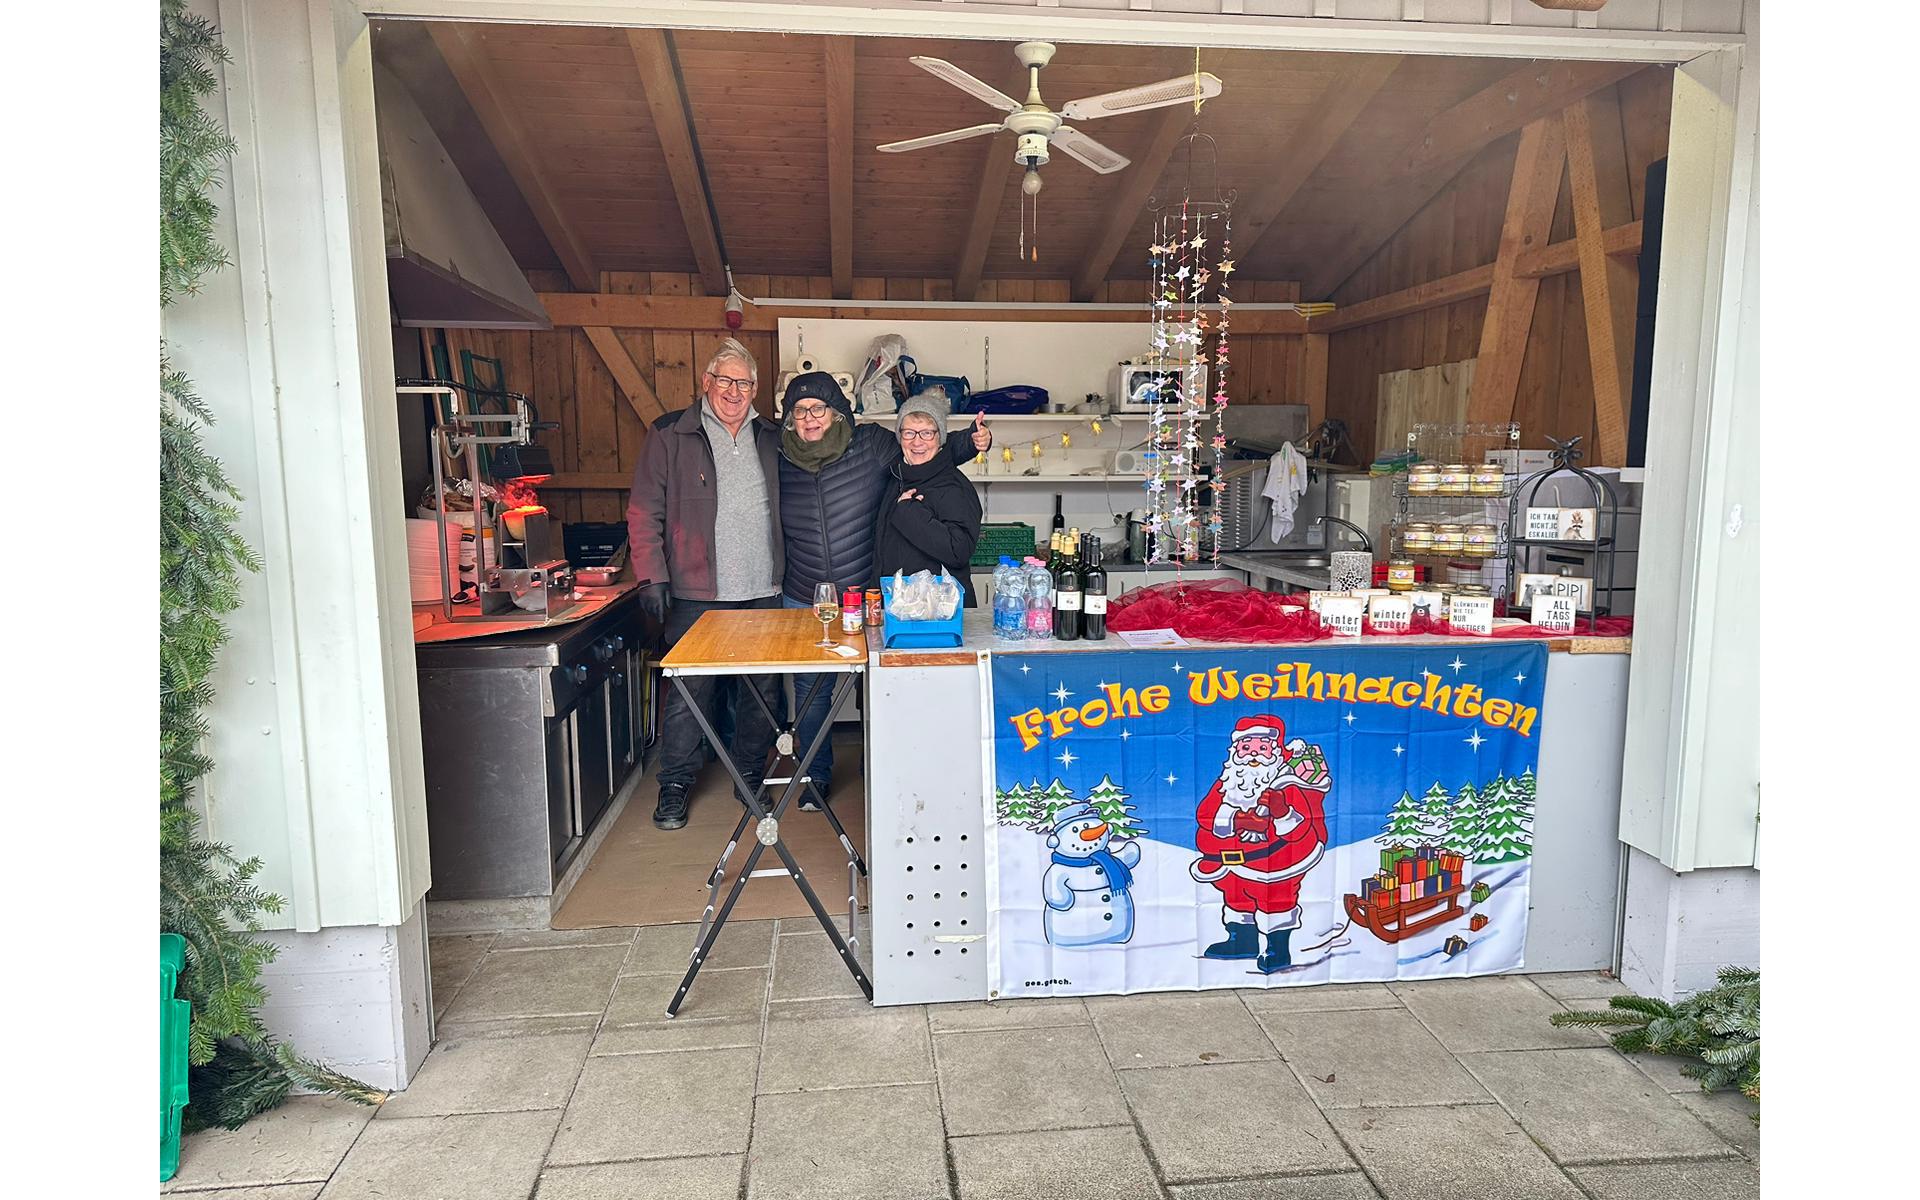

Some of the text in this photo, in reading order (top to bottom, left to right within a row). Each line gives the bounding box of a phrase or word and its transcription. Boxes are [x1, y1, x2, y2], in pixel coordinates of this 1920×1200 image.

[1553, 601, 1570, 610] ALL
[1373, 609, 1407, 619] winter
[1547, 610, 1570, 620] TAGS
[1322, 614, 1359, 625] winter
[1372, 620, 1407, 629] zauber
[1452, 624, 1486, 632] LUSTIGER
[1538, 620, 1570, 631] HELDIN
[1009, 661, 1538, 752] Frohe Weihnachten
